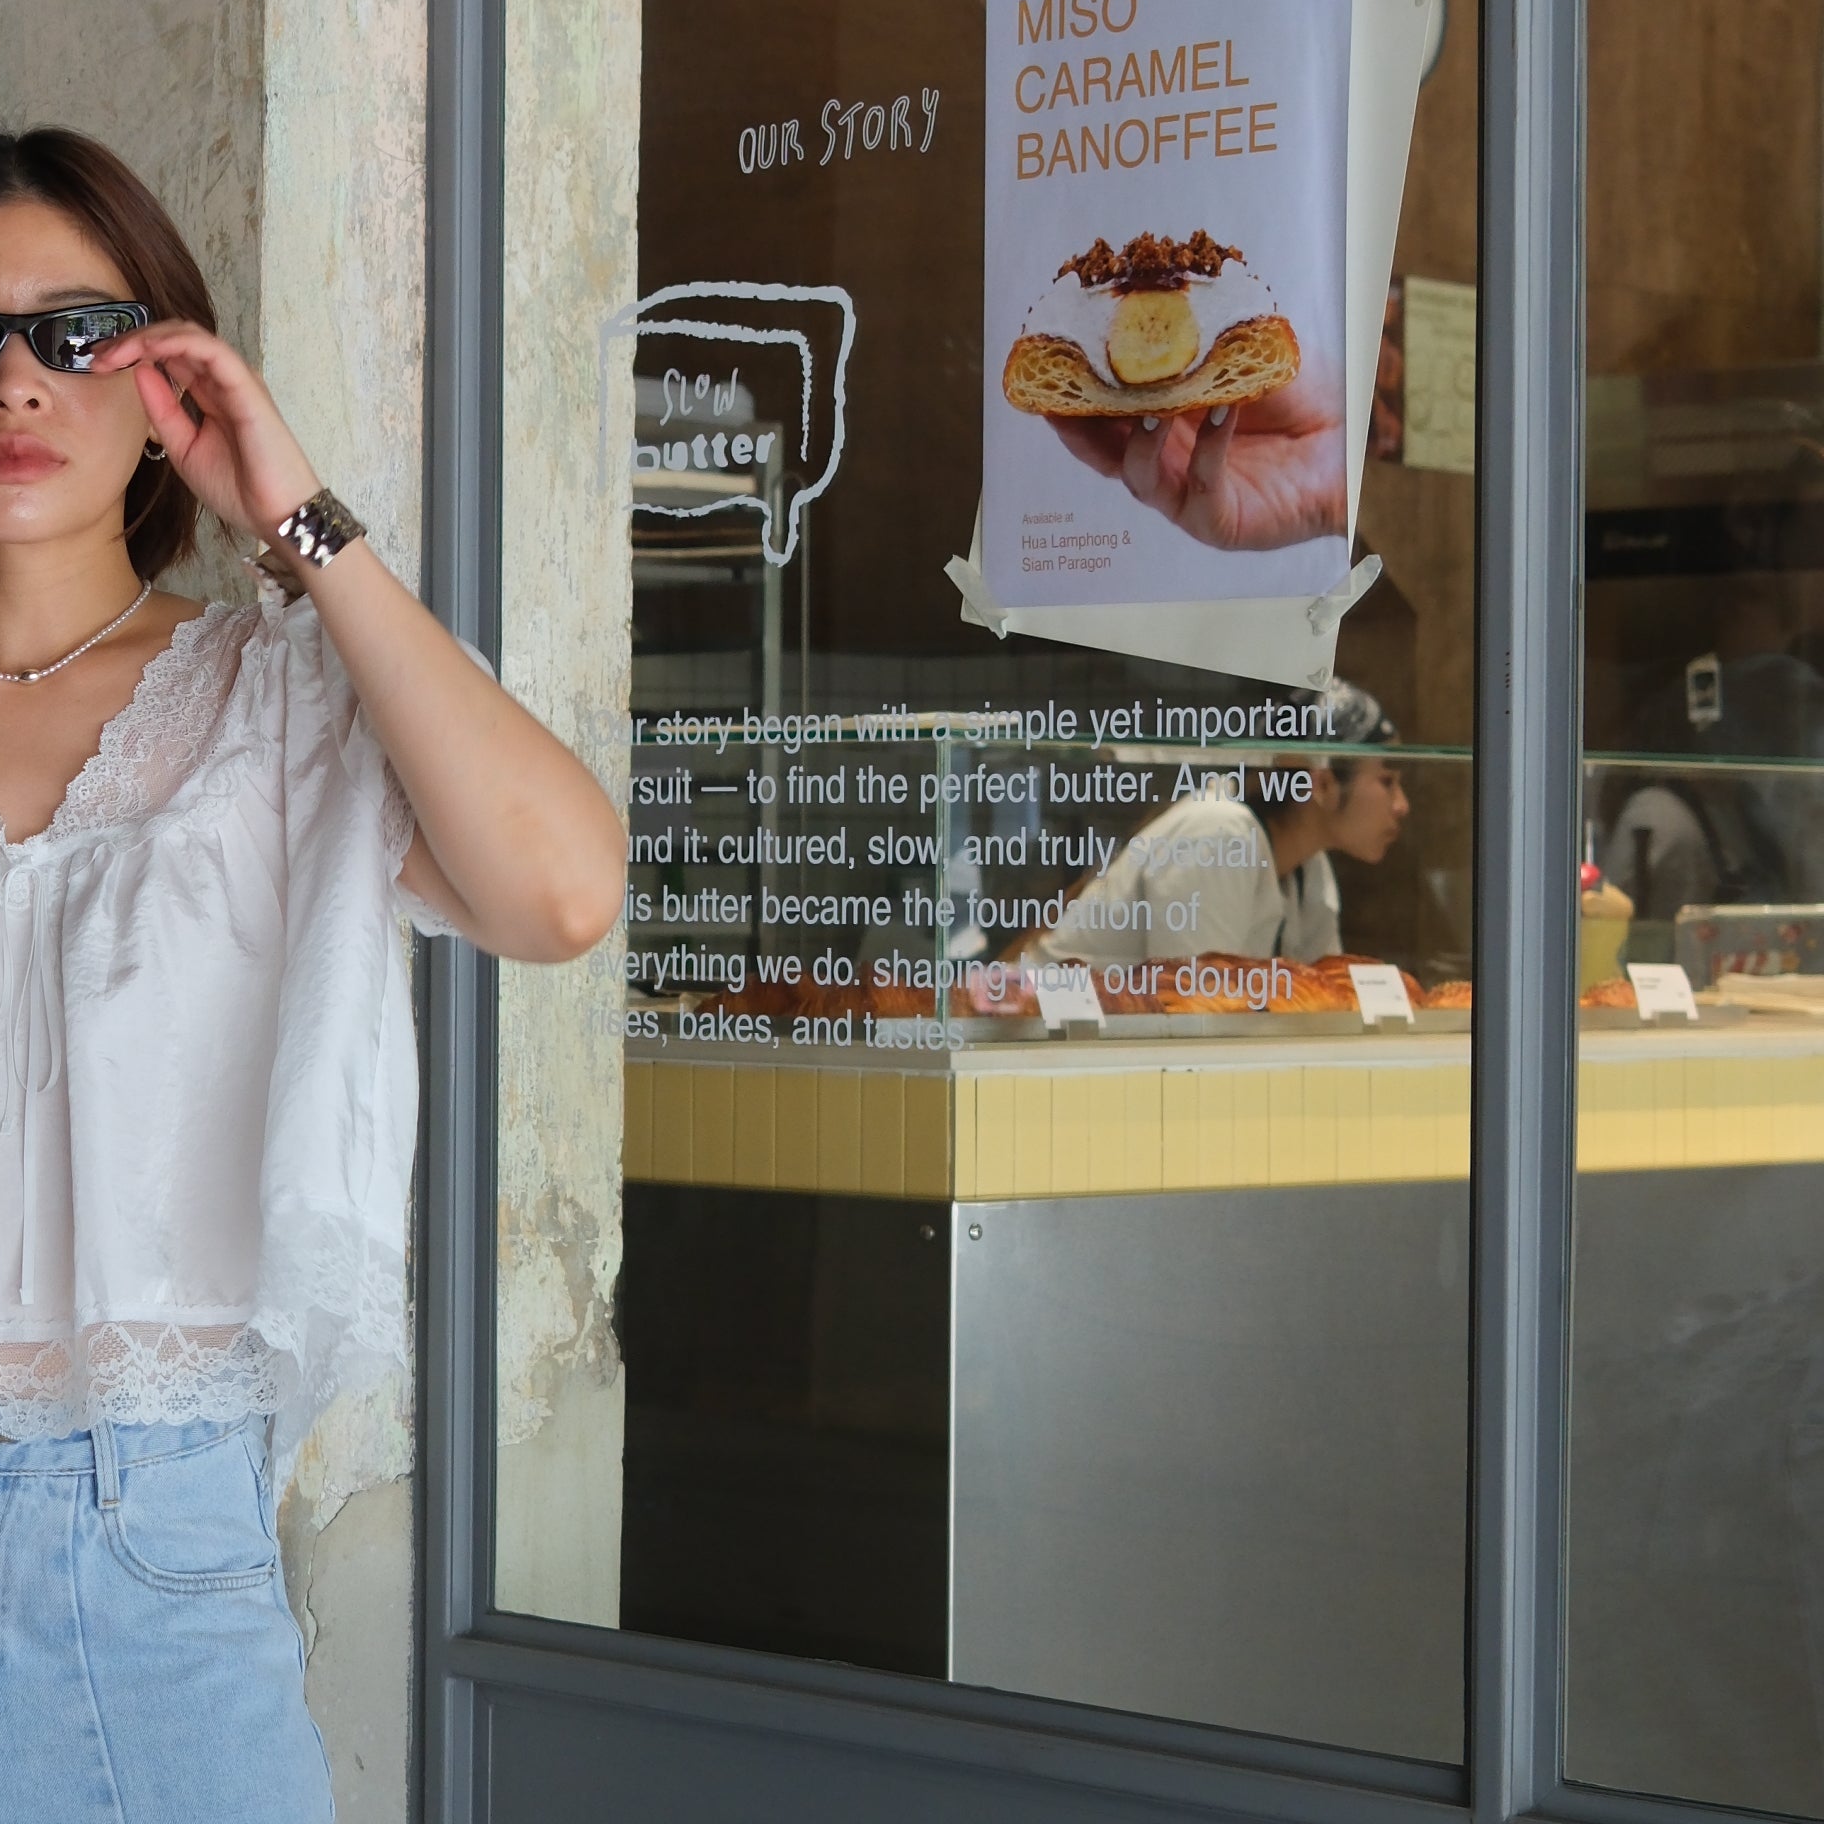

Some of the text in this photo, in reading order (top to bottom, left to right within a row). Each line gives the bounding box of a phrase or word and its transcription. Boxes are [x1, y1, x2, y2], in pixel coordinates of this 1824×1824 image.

[1014, 39, 1250, 114] CARAMEL
[738, 87, 939, 174] OUR STORY
[1016, 102, 1278, 181] BANOFFEE
[630, 430, 776, 473] butter
[1022, 512, 1074, 525] Available at
[1022, 530, 1132, 550] Hua Lamphong &
[1022, 555, 1112, 573] Siam Paragon
[655, 711, 732, 754] story
[743, 707, 842, 754] began
[854, 703, 919, 743] with
[931, 713, 951, 742] a
[964, 700, 1077, 750] simple
[1090, 701, 1143, 749] yet
[1156, 697, 1336, 747] important
[747, 769, 776, 804] to
[787, 765, 845, 804] find
[856, 765, 908, 804] the
[920, 763, 1038, 813] perfect
[1049, 763, 1159, 804] butter.
[1171, 761, 1246, 803] And
[1258, 768, 1313, 803] we
[683, 827, 708, 864] it:
[718, 827, 855, 870] cultured,
[867, 826, 949, 871] slow,
[963, 827, 1027, 866] and
[1039, 826, 1116, 876] truly
[1128, 827, 1268, 875] special.
[663, 884, 753, 923] butter
[762, 886, 891, 926] became
[902, 887, 956, 927] the
[967, 889, 1152, 932] foundation
[1165, 891, 1200, 932] of
[588, 944, 746, 994] everything
[757, 954, 802, 984] we
[873, 949, 1007, 1002] shaping
[1020, 952, 1091, 993] how
[1103, 962, 1164, 995] our
[1175, 956, 1293, 1011] dough
[587, 1000, 975, 1051] rises, bakes, and tastes.
